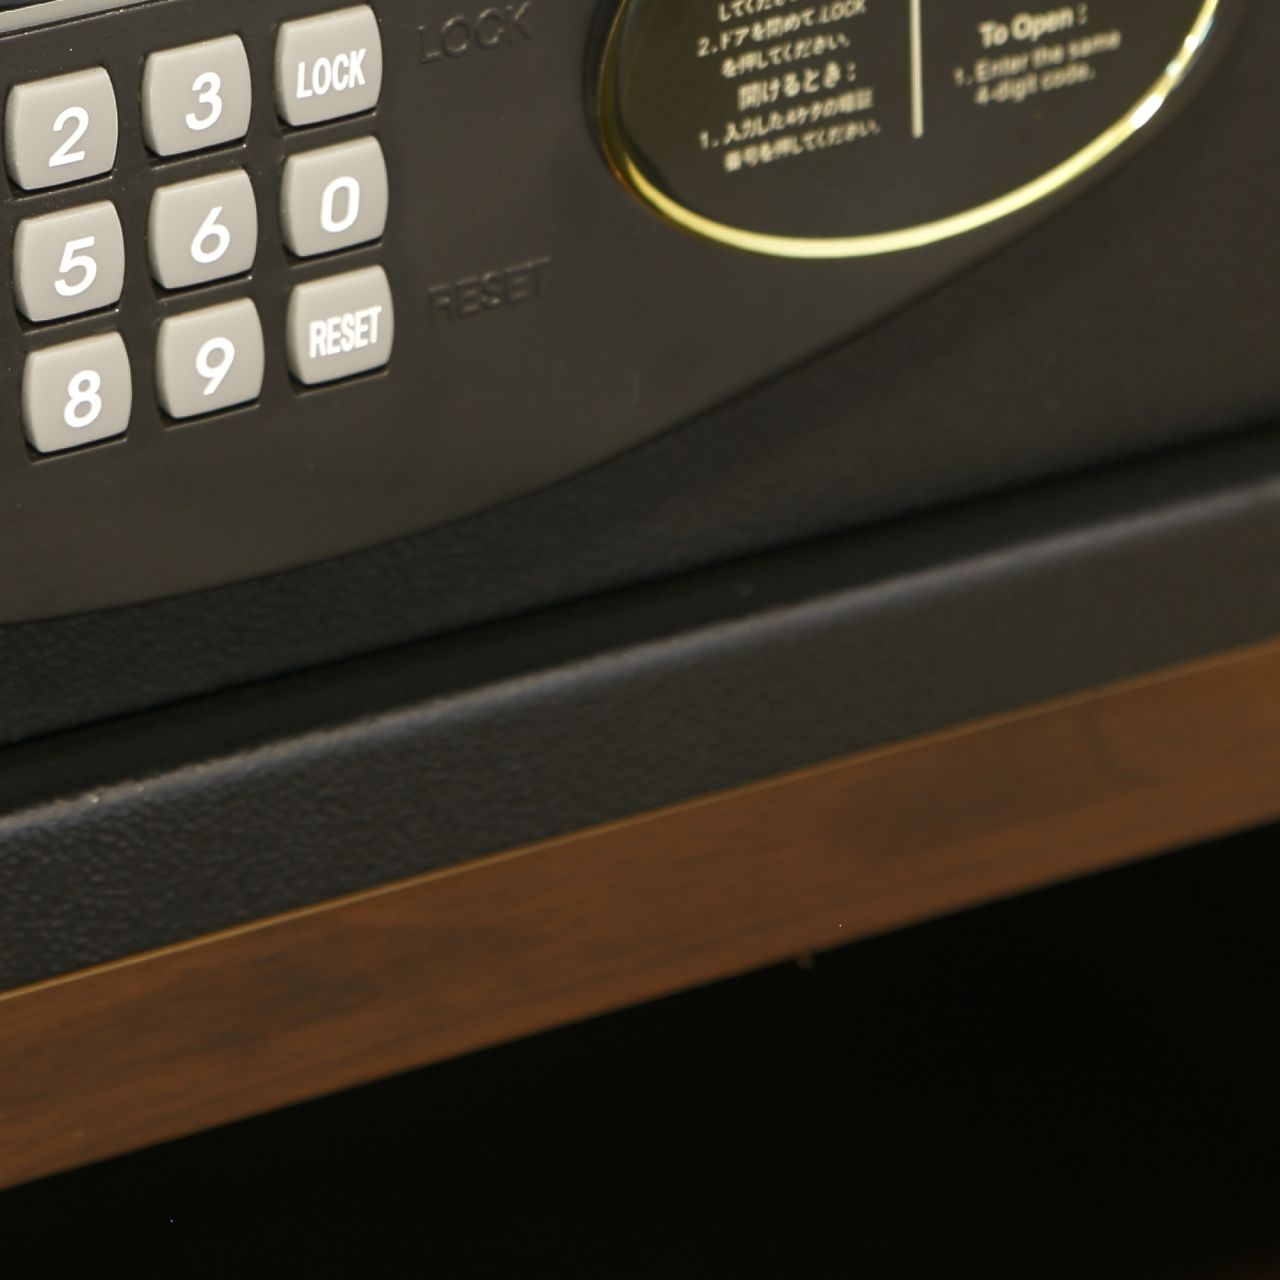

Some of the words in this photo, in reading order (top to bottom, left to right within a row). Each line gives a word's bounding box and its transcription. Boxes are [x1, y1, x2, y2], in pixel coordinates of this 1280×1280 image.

[978, 21, 1009, 48] To
[1011, 7, 1074, 42] Open
[296, 48, 368, 99] LOCK
[974, 53, 1028, 83] Enter
[185, 71, 223, 131] 3
[48, 106, 89, 167] 2
[320, 175, 360, 233] 0
[190, 206, 231, 264] 6
[54, 235, 97, 297] 5
[427, 255, 553, 326] RESET
[308, 305, 382, 359] RESET
[195, 336, 235, 396] 9
[63, 369, 102, 428] 8
